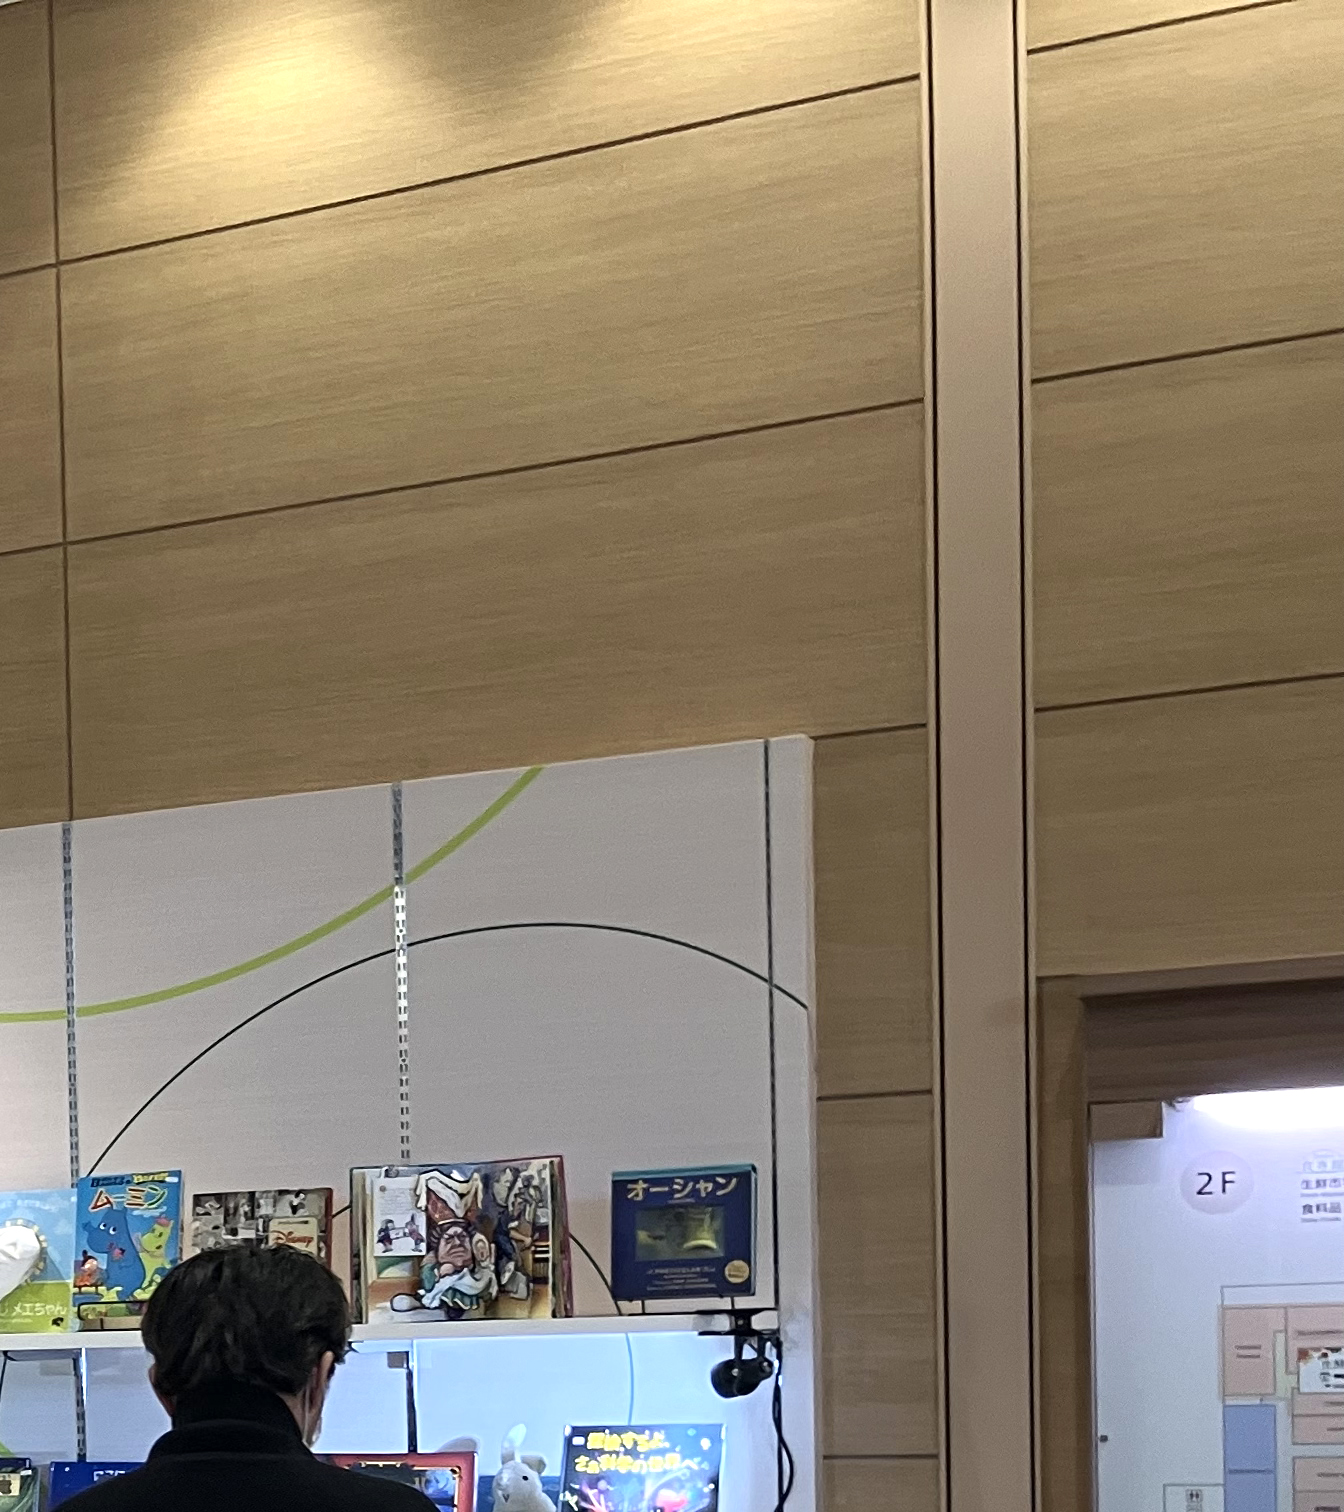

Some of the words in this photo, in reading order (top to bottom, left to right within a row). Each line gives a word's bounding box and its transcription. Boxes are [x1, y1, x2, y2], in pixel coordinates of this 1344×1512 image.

[626, 1176, 737, 1201] オーシャン
[1196, 1171, 1236, 1195] 2F
[89, 1185, 167, 1212] ムーミン
